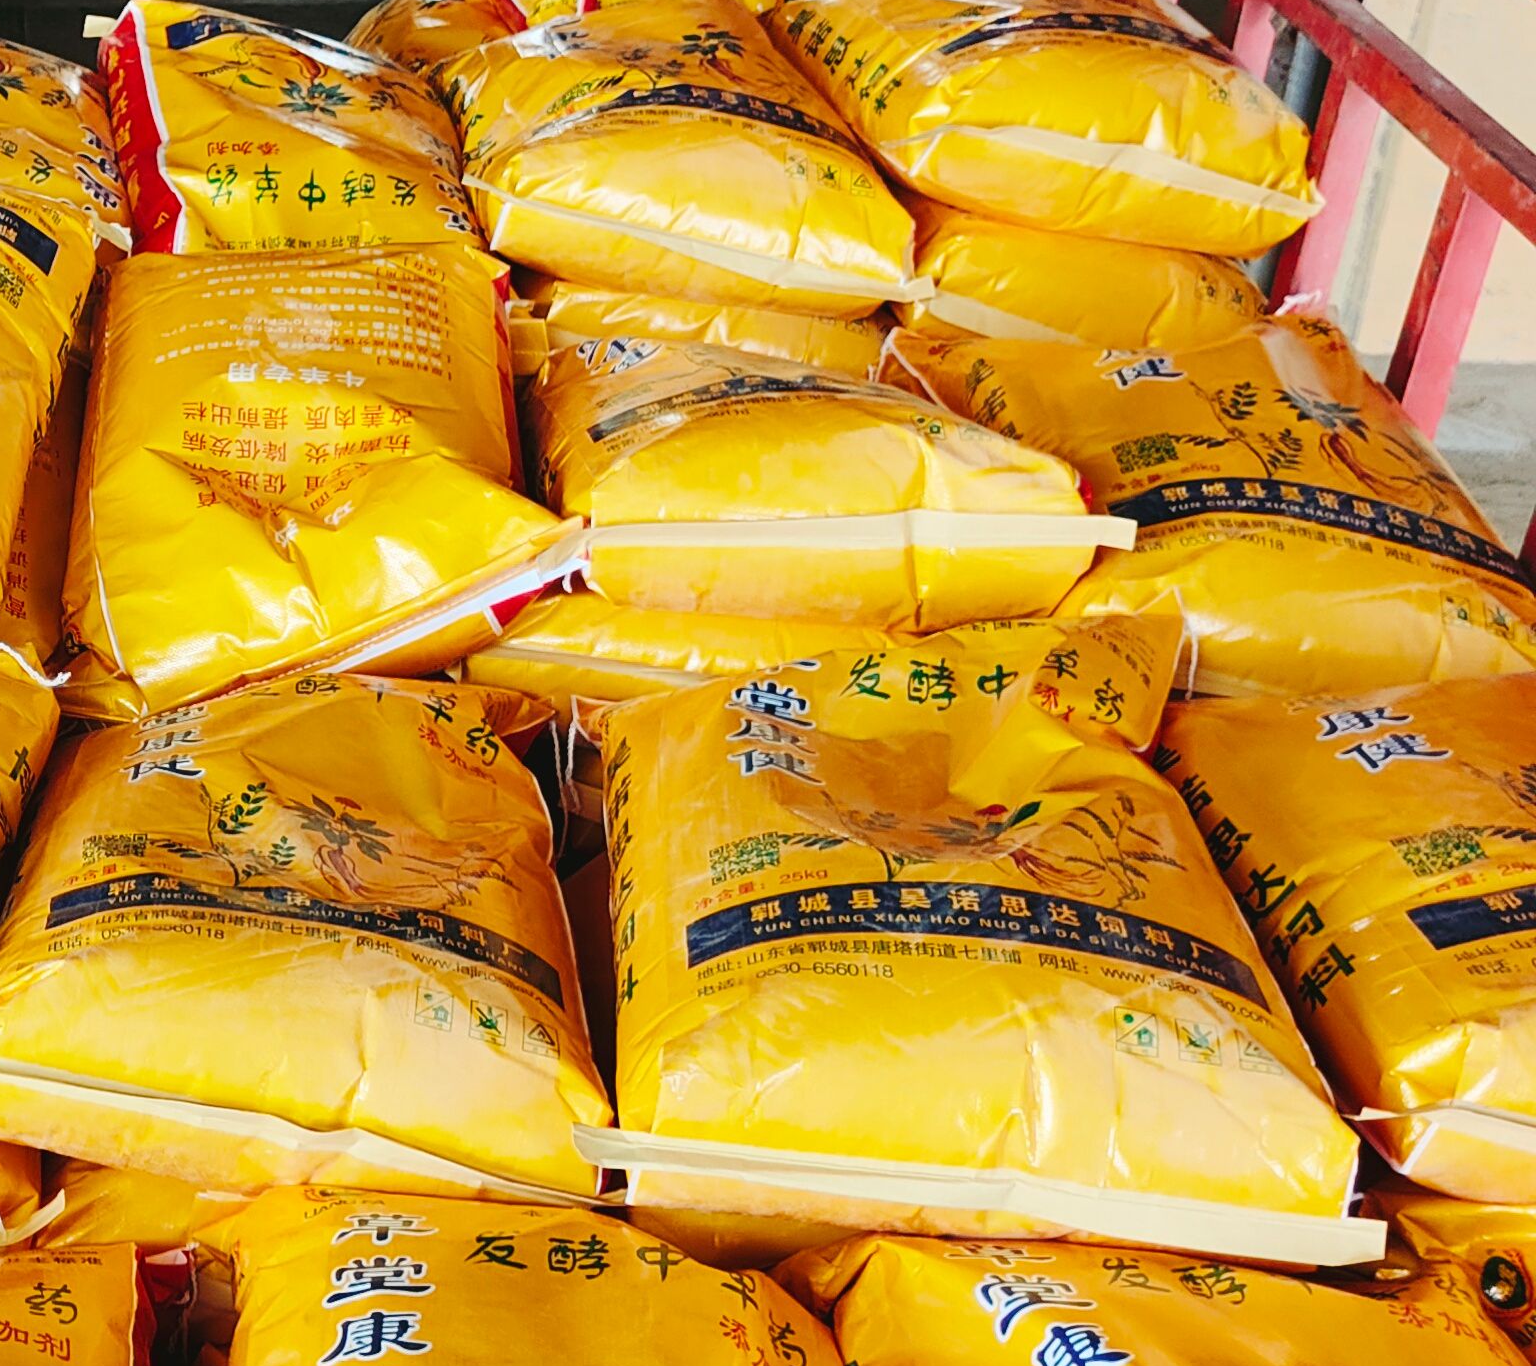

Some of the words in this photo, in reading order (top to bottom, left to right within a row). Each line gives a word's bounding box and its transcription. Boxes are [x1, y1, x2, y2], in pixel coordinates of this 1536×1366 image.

[207, 141, 280, 156] 添加剂
[206, 163, 420, 211] 发酵中草药
[227, 361, 366, 389] 牛羊专用
[182, 402, 288, 430] 提前出栏
[304, 405, 412, 429] 改善肉质
[182, 430, 287, 462] 降低发病
[779, 867, 829, 886] 25kg
[750, 887, 1215, 961] 郓城县昊诺思达饲料厂
[799, 914, 865, 928] CHENG
[873, 912, 923, 924] XIAN
[930, 914, 970, 927] HAO
